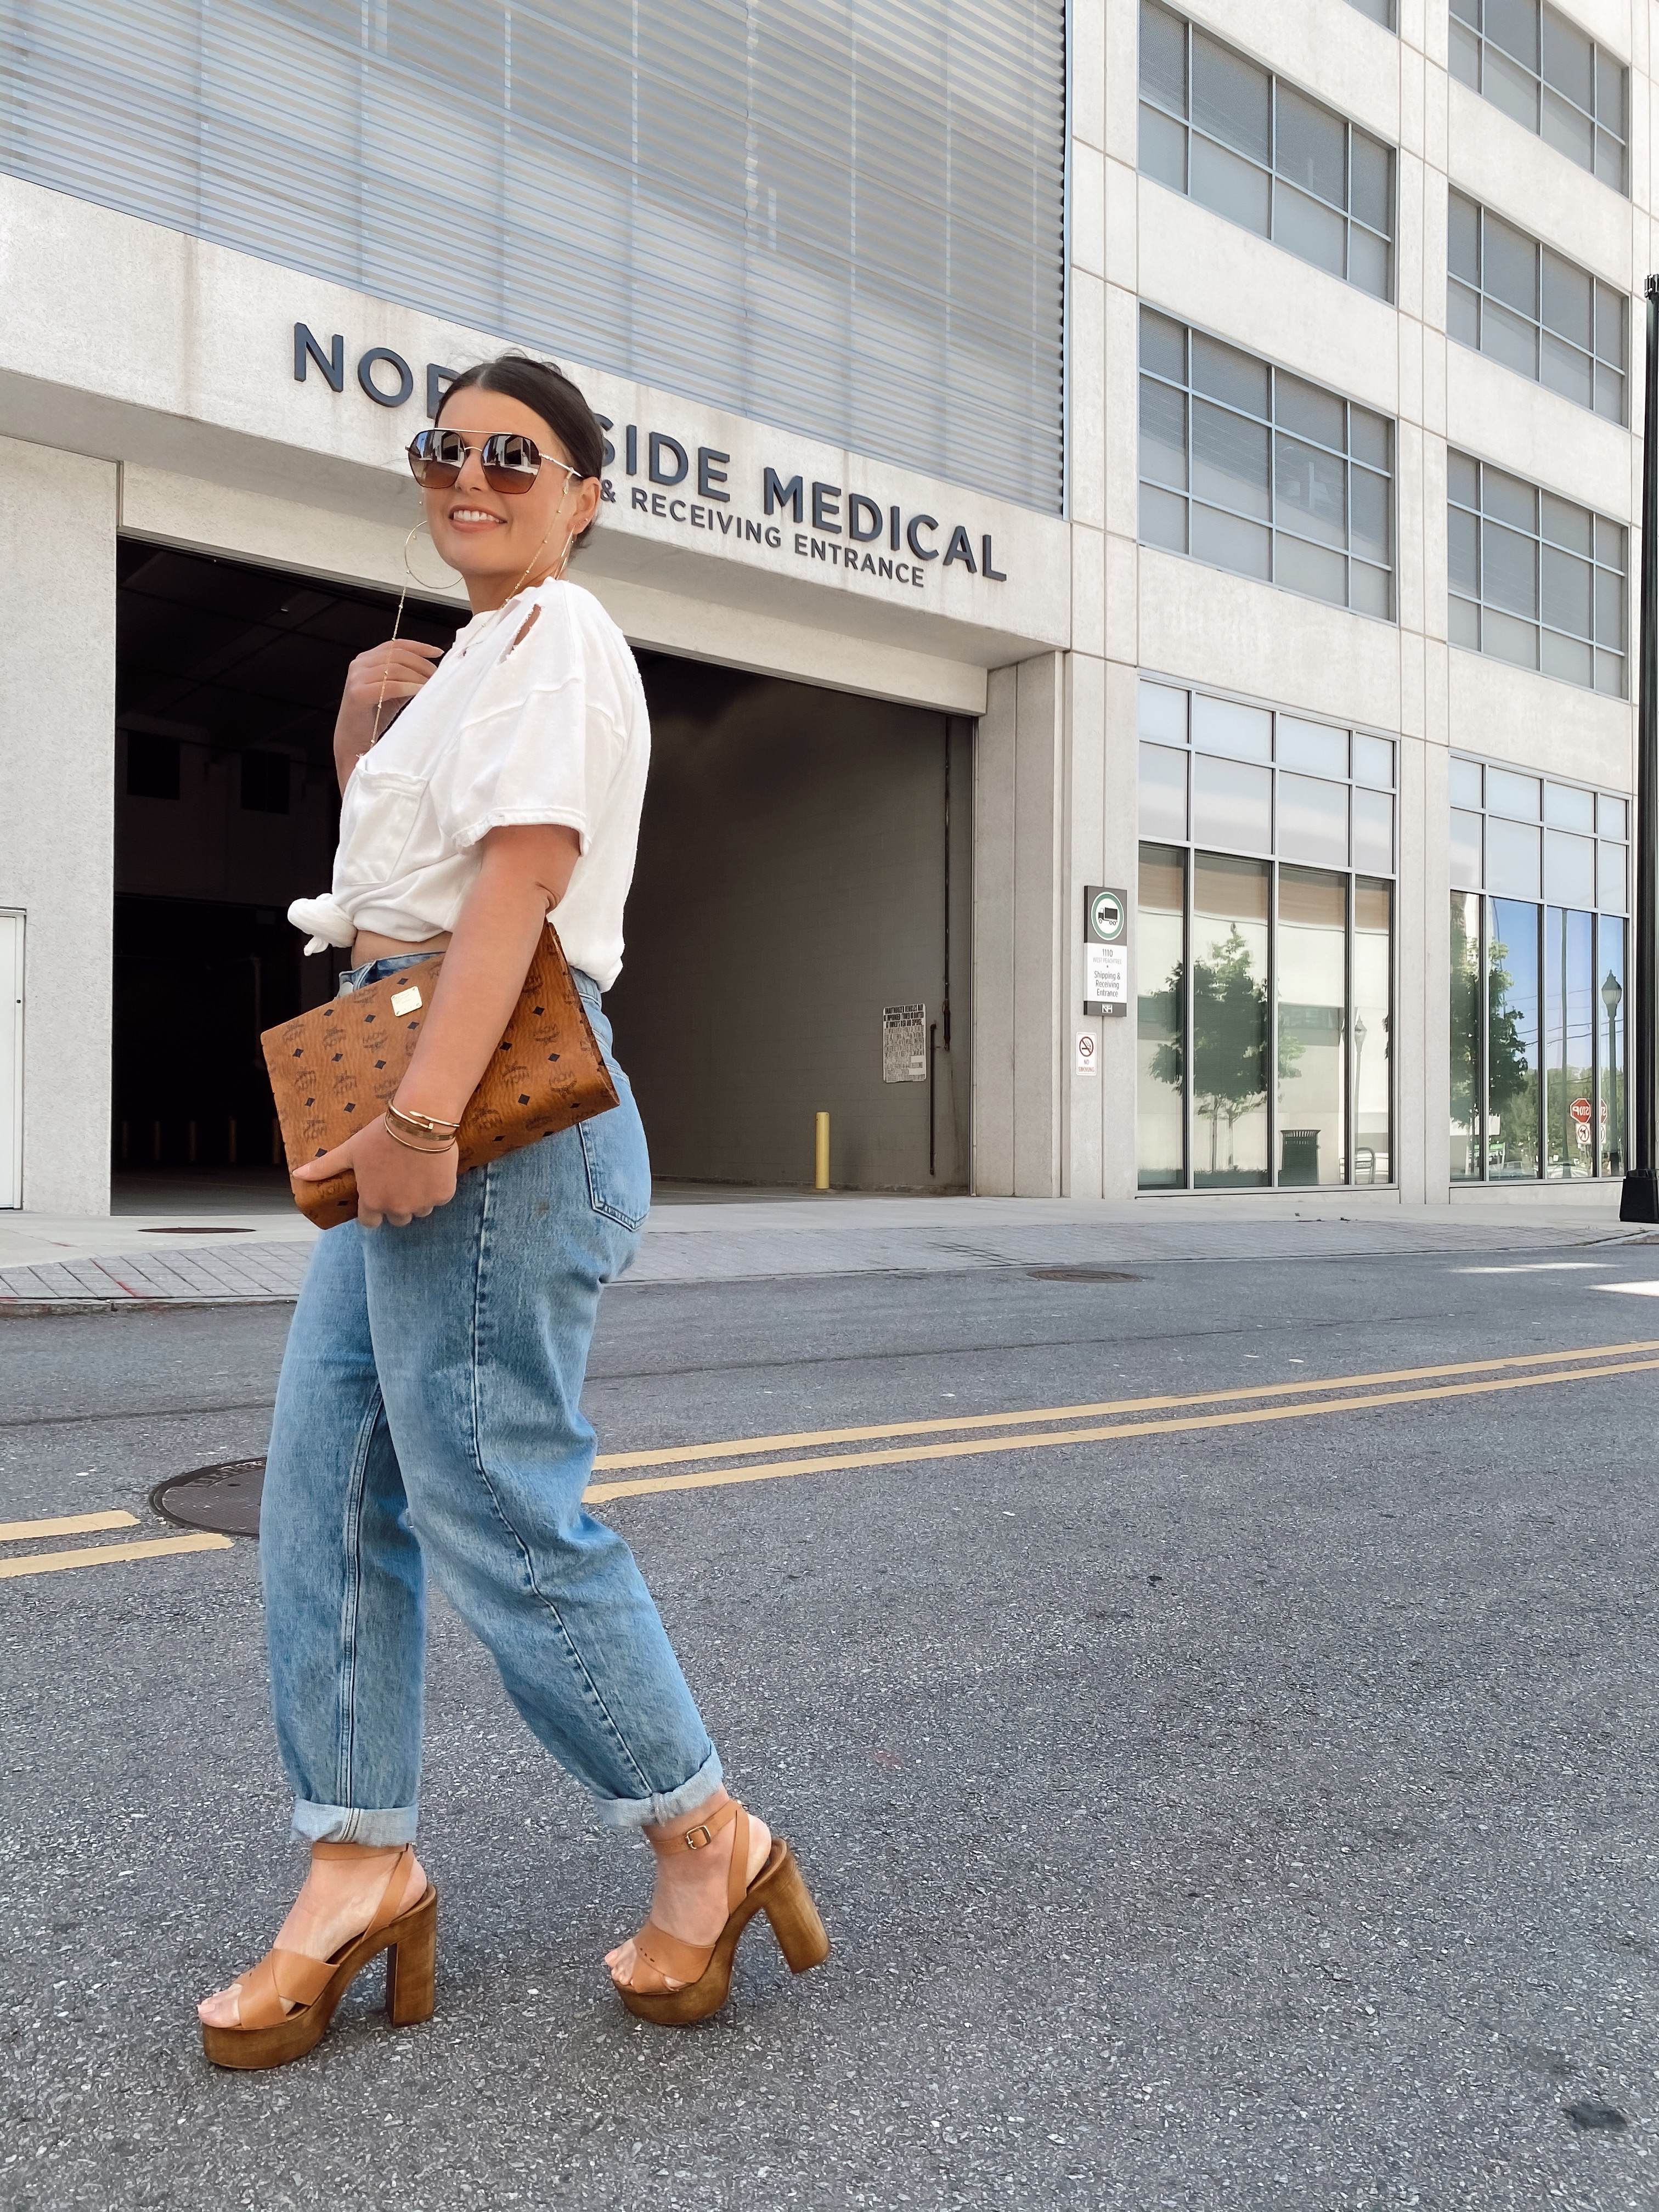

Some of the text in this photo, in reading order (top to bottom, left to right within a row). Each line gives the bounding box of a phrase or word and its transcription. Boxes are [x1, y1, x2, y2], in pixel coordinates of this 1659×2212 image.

[764, 467, 1007, 582] MEDICAL
[601, 479, 925, 588] & RECEIVING ENTRANCE
[1102, 949, 1113, 957] 1110
[1094, 970, 1116, 981] Shipping
[1096, 980, 1119, 990] Receiving
[1097, 989, 1118, 997] Entrance
